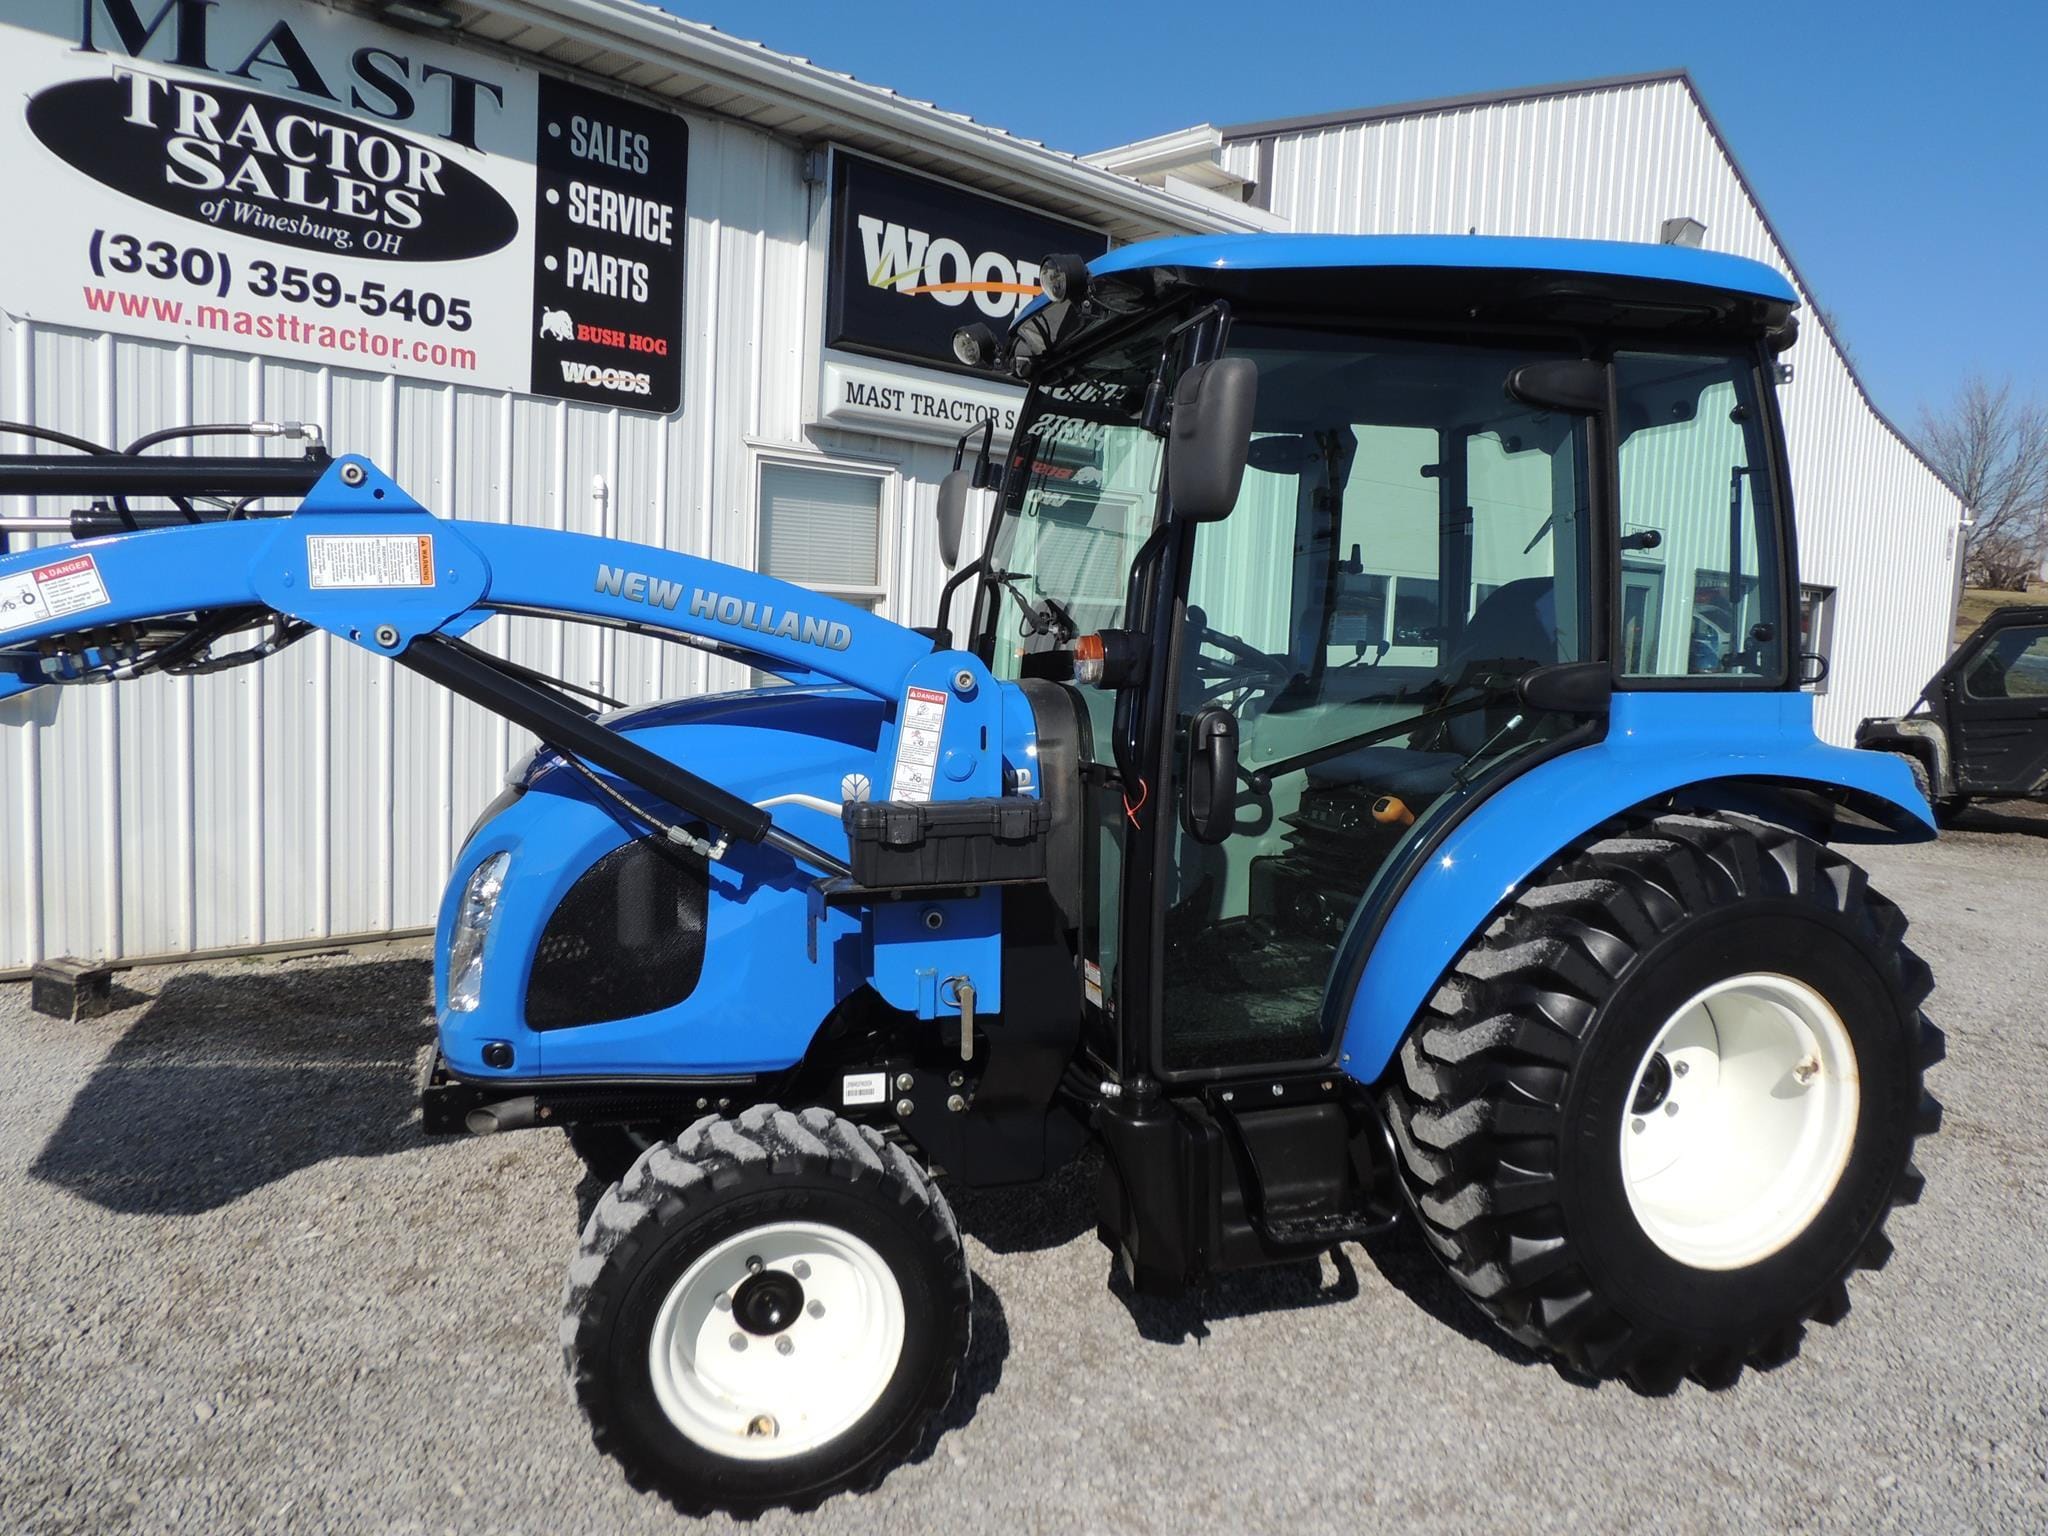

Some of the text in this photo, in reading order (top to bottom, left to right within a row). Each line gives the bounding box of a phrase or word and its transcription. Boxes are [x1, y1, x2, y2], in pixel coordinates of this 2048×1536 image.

[70, 0, 504, 155] MAST
[111, 64, 446, 196] TRACTOR
[571, 115, 649, 174] SALES
[165, 136, 422, 229] SALES
[200, 198, 403, 255] of Winesburg, OH
[568, 181, 673, 246] SERVICE
[88, 228, 473, 333] (330) 359-5405
[566, 246, 649, 303] PARTS
[83, 286, 477, 371] www.masttractor.com
[577, 324, 668, 356] BUSH HOG
[560, 360, 650, 395] WOODS
[845, 381, 905, 412] MAST
[910, 393, 1000, 428] TRACTOR
[48, 560, 89, 577] DANGER
[421, 549, 430, 581] WARNING
[594, 563, 852, 652] NEW HOLLAND
[916, 692, 945, 702] DANGER
